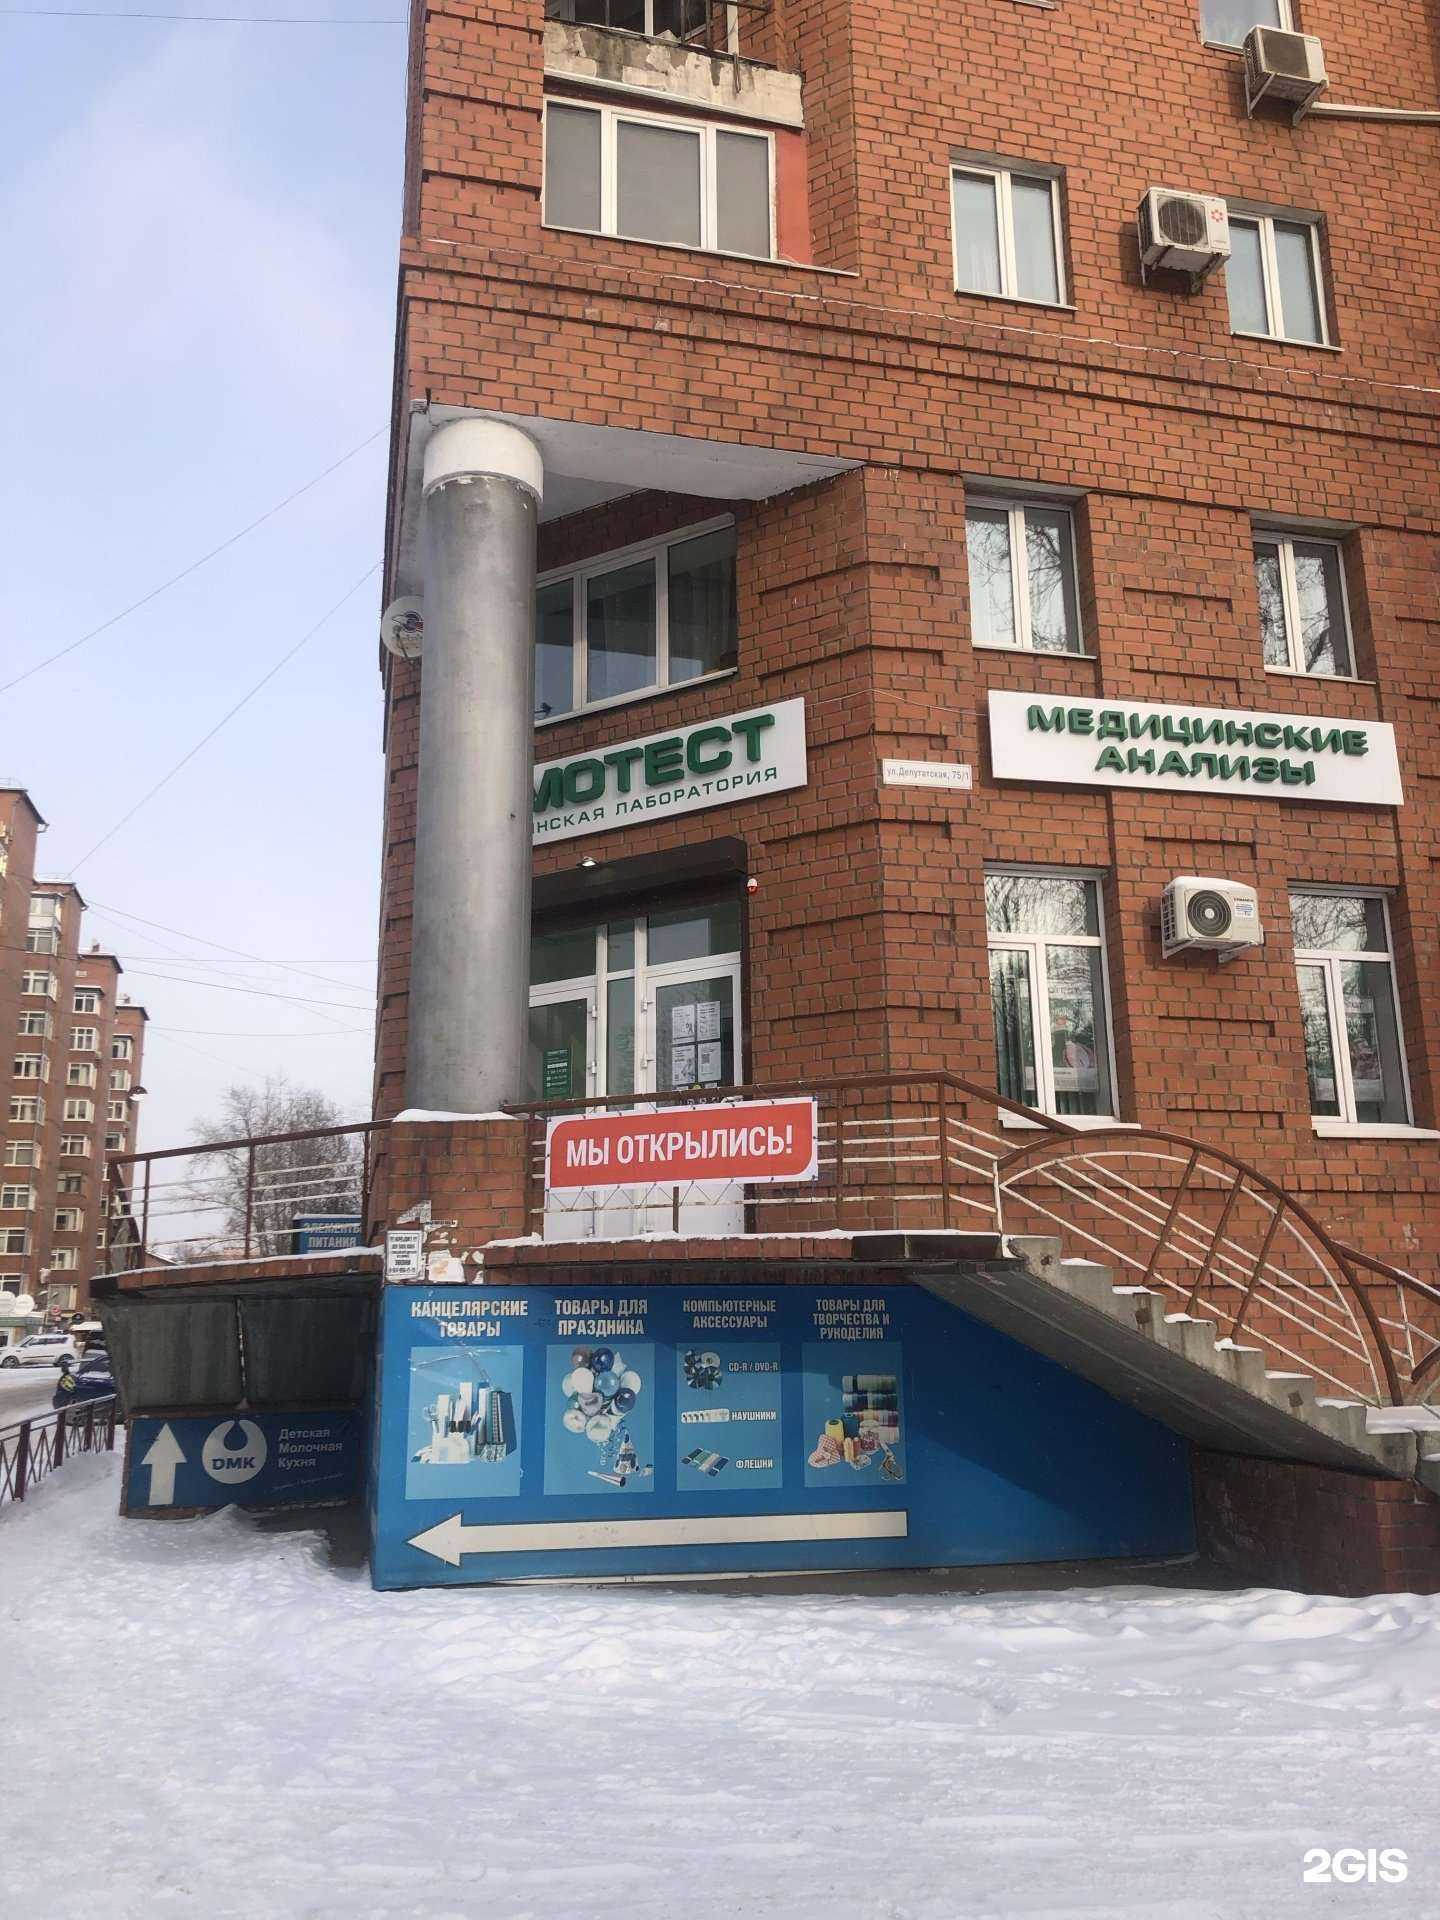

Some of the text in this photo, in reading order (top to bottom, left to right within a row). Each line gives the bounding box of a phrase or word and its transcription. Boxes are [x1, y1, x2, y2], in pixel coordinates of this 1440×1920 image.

[1027, 704, 1369, 756] МЕДИЦИНСКИЕ
[1095, 745, 1316, 786] АНАЛИЗЫ
[533, 767, 778, 834] НСКАЯ ЛАБОРАТОРИЯ
[566, 1124, 794, 1168] МЫ ОТКРЫЛИСЬ!
[308, 1236, 357, 1248] ПИТАНИЯ
[411, 1300, 529, 1319] КАНЦЕЛЯРСКИЕ
[555, 1299, 648, 1318] ТОВАРЫ ДЛЯ
[683, 1299, 777, 1313] КОМПЬЮТЕРНЫЕ
[816, 1299, 886, 1314] ТОВАРЫ ДЛЯ
[693, 1315, 769, 1329] АКСЕССУАРЫ
[813, 1313, 890, 1326] ТВОРЧЕСТВА И
[440, 1320, 501, 1338] ТОВАРЫ
[558, 1319, 645, 1337] ПРАЗДНИКА
[820, 1327, 884, 1341] РУКОДЕЛИЯ
[728, 1361, 748, 1372] CD-R
[731, 1410, 777, 1422] НАУШНИКИ
[278, 1428, 331, 1442] Детская
[278, 1442, 344, 1454] Молочная
[212, 1456, 256, 1471] DMK
[277, 1456, 317, 1472] Кухня
[735, 1458, 774, 1470] ФЛЕШКИ
